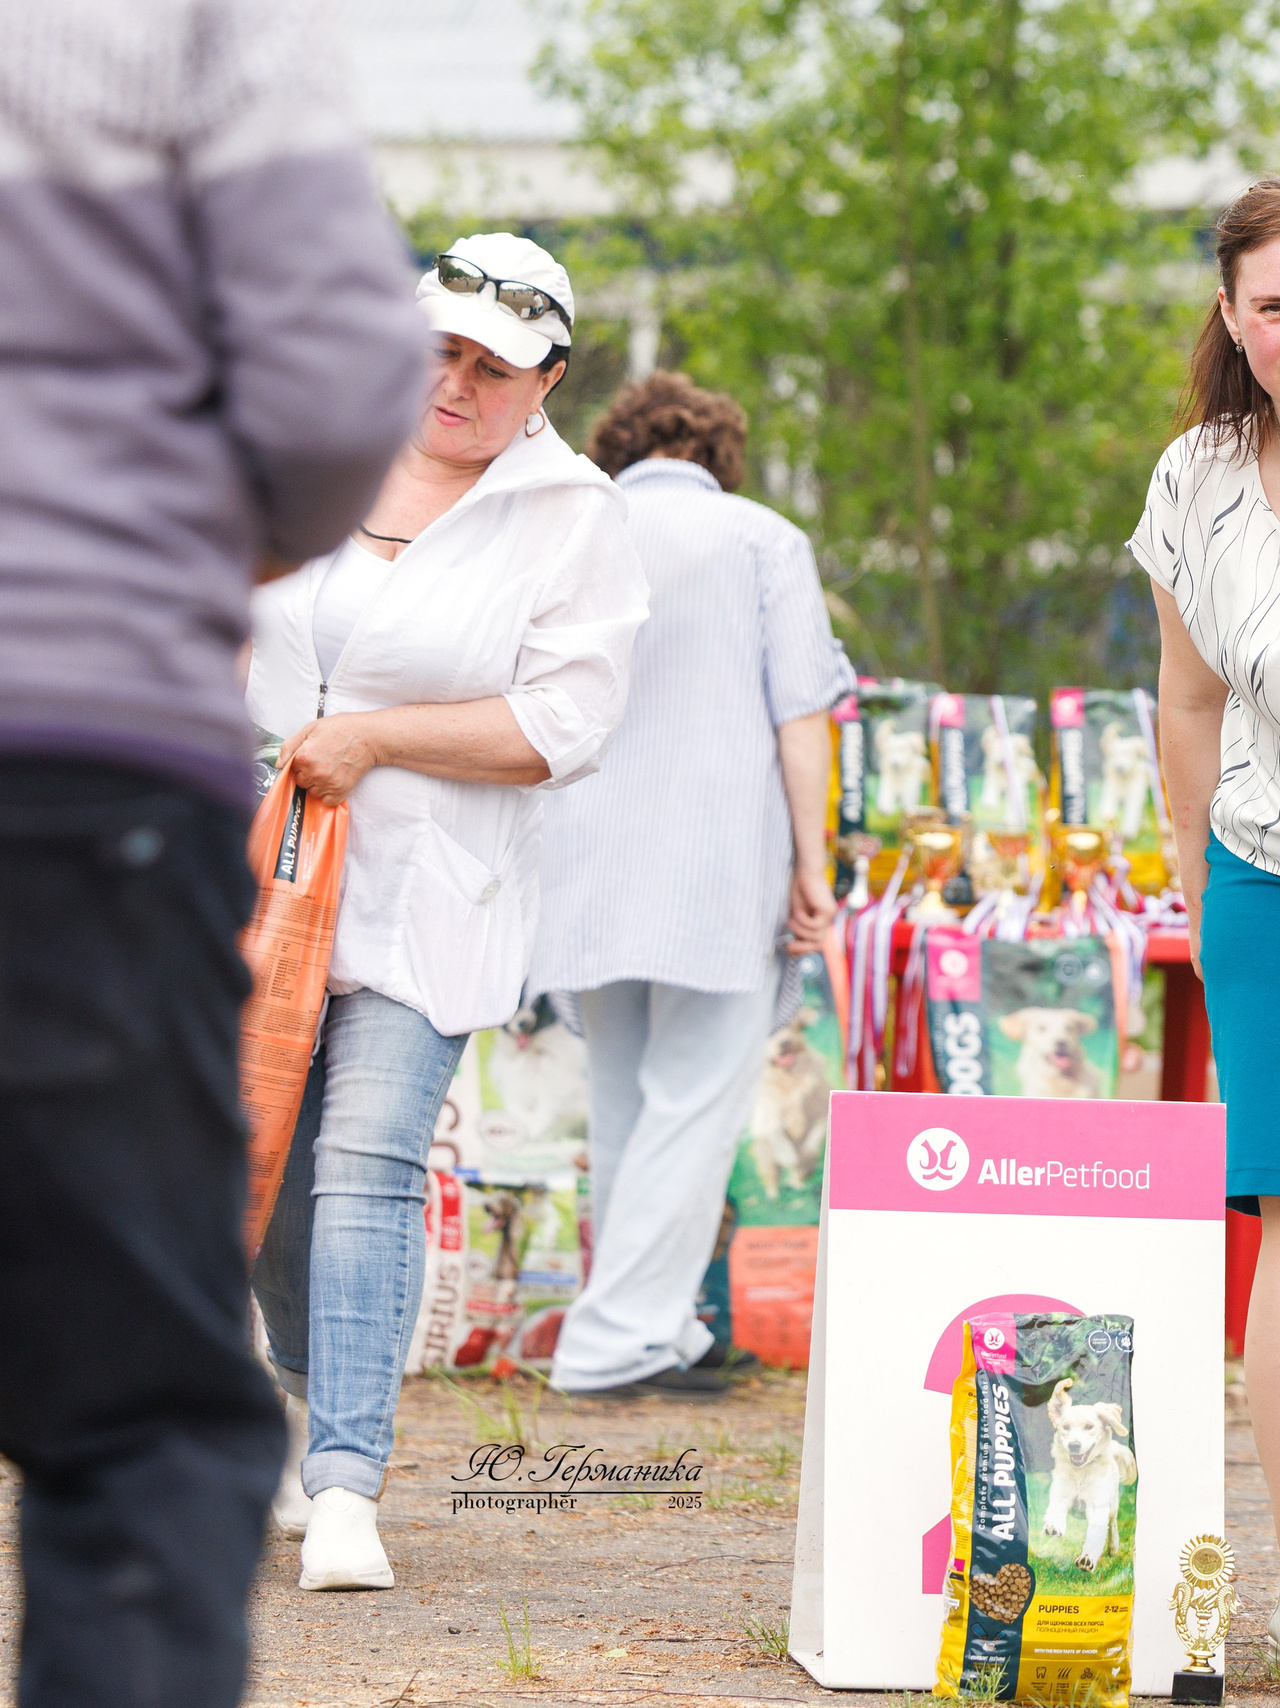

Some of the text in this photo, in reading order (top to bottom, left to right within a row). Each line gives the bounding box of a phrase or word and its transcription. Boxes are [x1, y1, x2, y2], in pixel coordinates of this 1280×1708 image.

[281, 852, 295, 874] ALL
[977, 1158, 1150, 1190] AllerPetfood
[982, 1381, 990, 1395] for
[982, 1396, 990, 1417] food
[992, 1384, 1016, 1488] PUPPIES
[981, 1442, 990, 1482] premium
[978, 1486, 988, 1530] Complete
[991, 1493, 1017, 1541] ALL
[1038, 1605, 1079, 1614] PUPPIES
